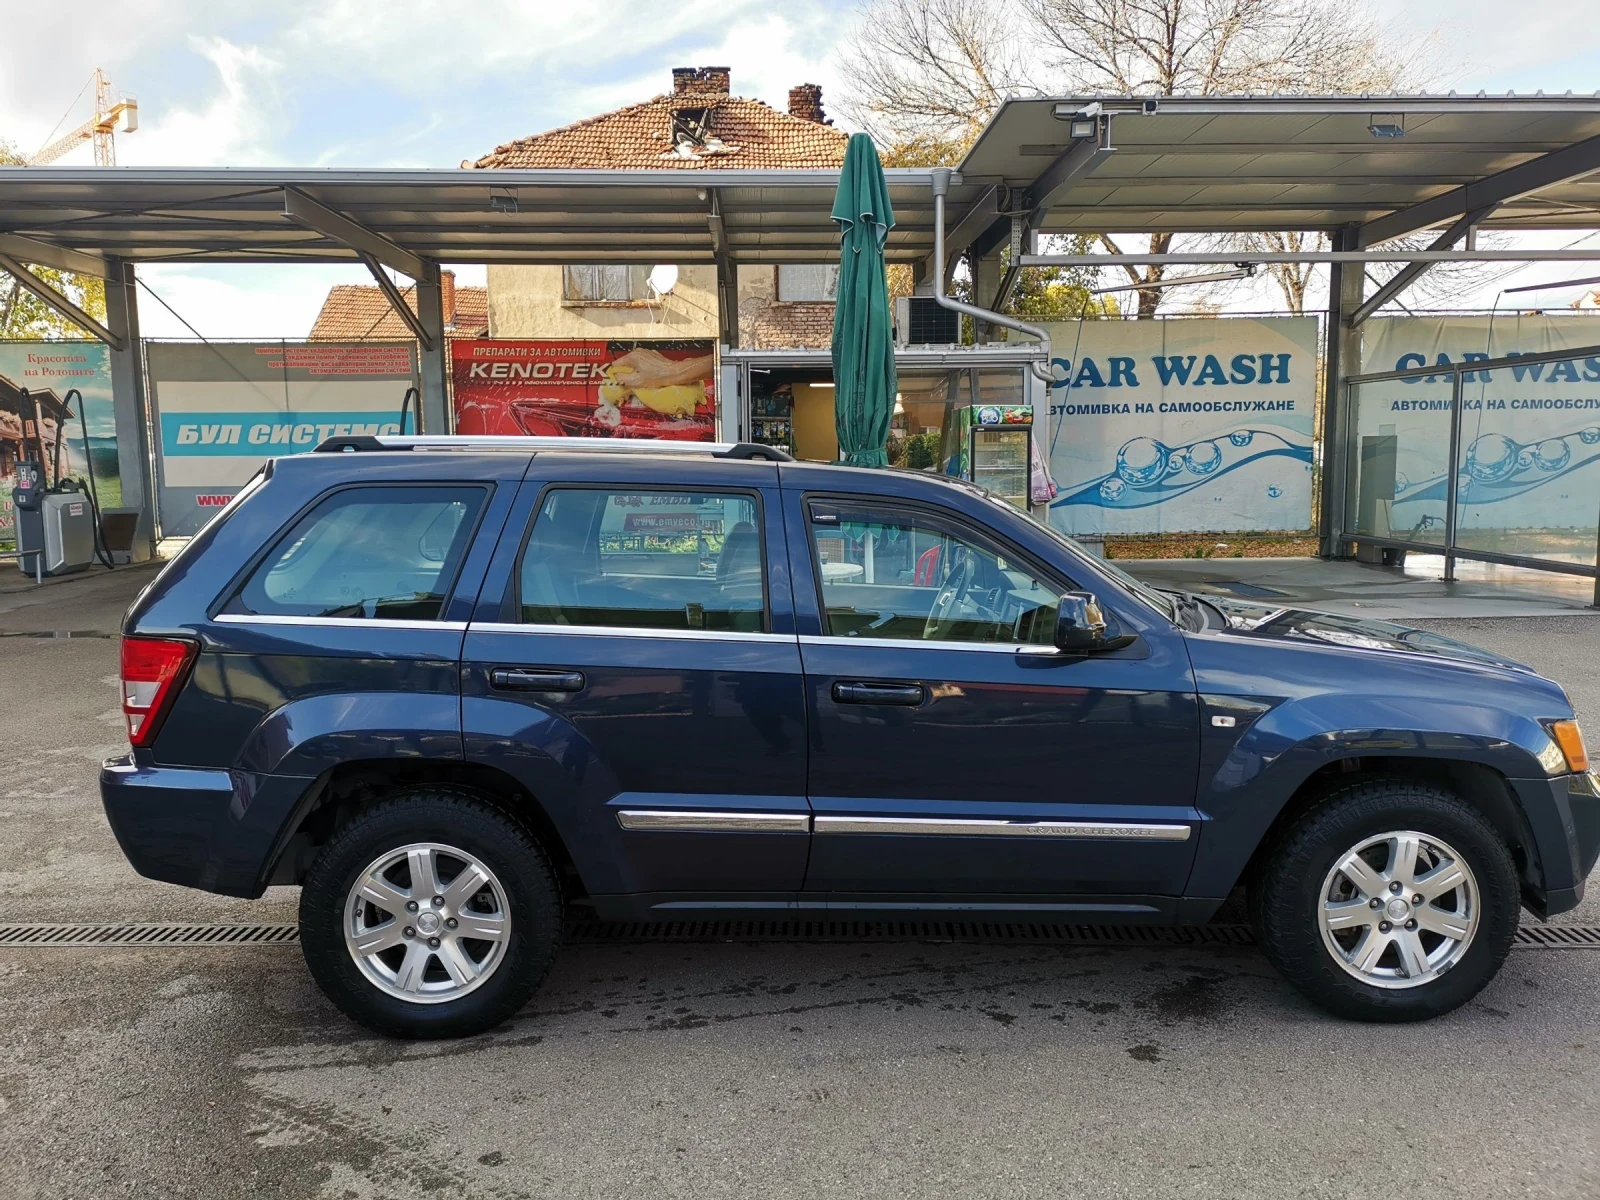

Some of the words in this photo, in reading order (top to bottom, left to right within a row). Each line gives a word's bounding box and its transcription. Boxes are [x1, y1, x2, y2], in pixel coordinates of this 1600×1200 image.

[28, 353, 87, 364] Красотата
[473, 347, 527, 357] ПРЕПАРАТИ
[530, 347, 541, 356] ЗА
[544, 347, 601, 356] АВТОМИВКИ
[42, 367, 95, 378] Родопите
[469, 362, 612, 379] KENOTEK
[1051, 356, 1141, 388] CAR
[1152, 353, 1293, 386] WASH
[1395, 352, 1493, 384] CAR
[1135, 402, 1154, 414] НА
[1158, 400, 1295, 413] САМООБСЛУЖАНЕ
[1391, 399, 1483, 411] АВТОМИКА
[1487, 399, 1507, 410] НА
[176, 424, 242, 445] БУЛ
[247, 423, 401, 445] СИСТЕМС
[1026, 826, 1078, 835] GRAND
[1082, 827, 1157, 837] CHEROKEE
